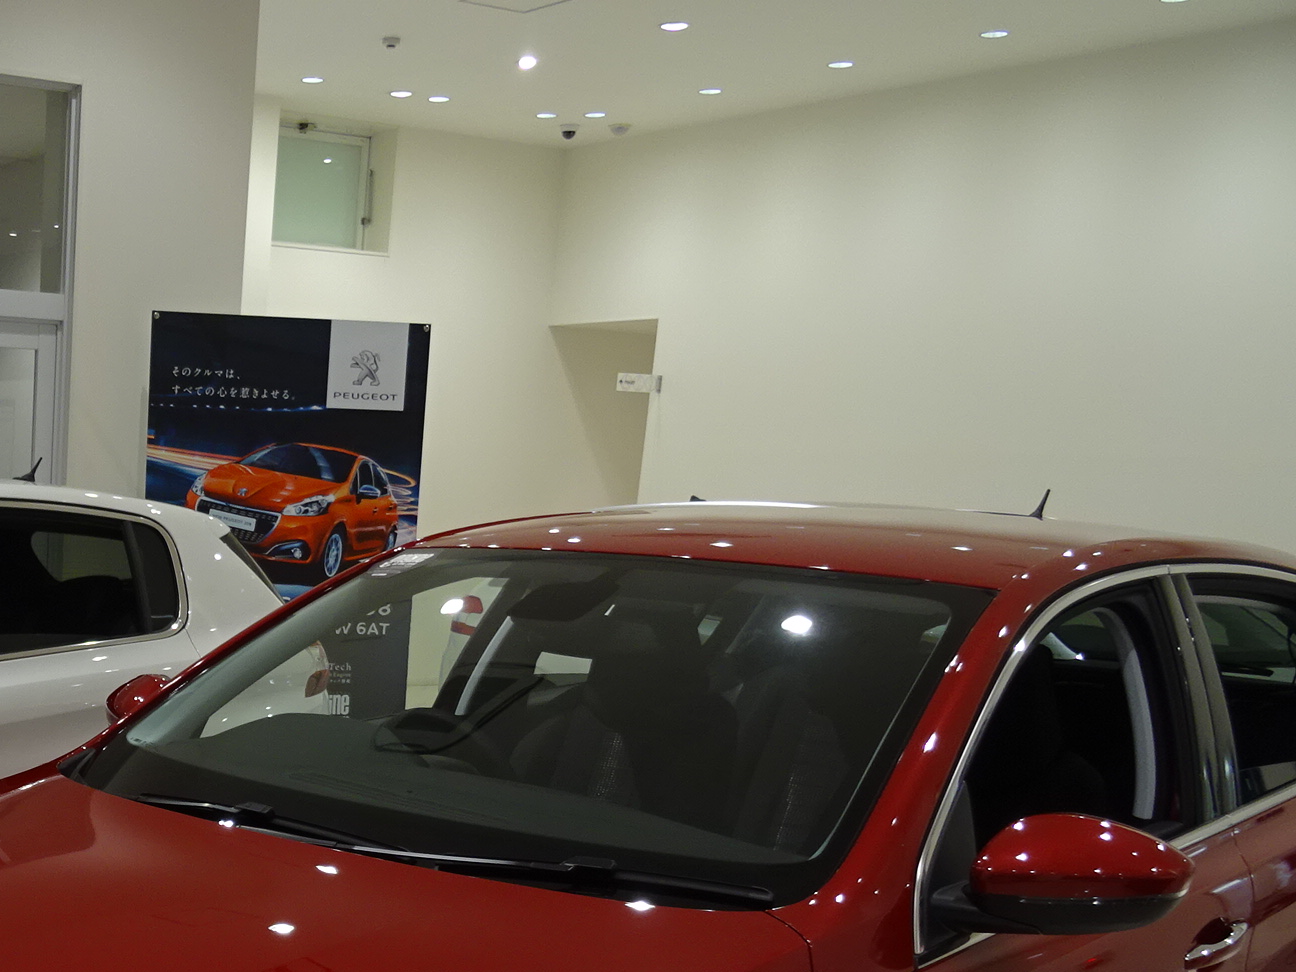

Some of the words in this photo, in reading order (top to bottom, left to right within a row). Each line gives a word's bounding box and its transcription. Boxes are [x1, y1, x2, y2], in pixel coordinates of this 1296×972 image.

[172, 366, 241, 380] そのクルマは、
[333, 392, 398, 402] PEUGEOT
[356, 622, 390, 635] 6AT
[329, 662, 352, 671] Tech
[328, 694, 350, 715] ine
